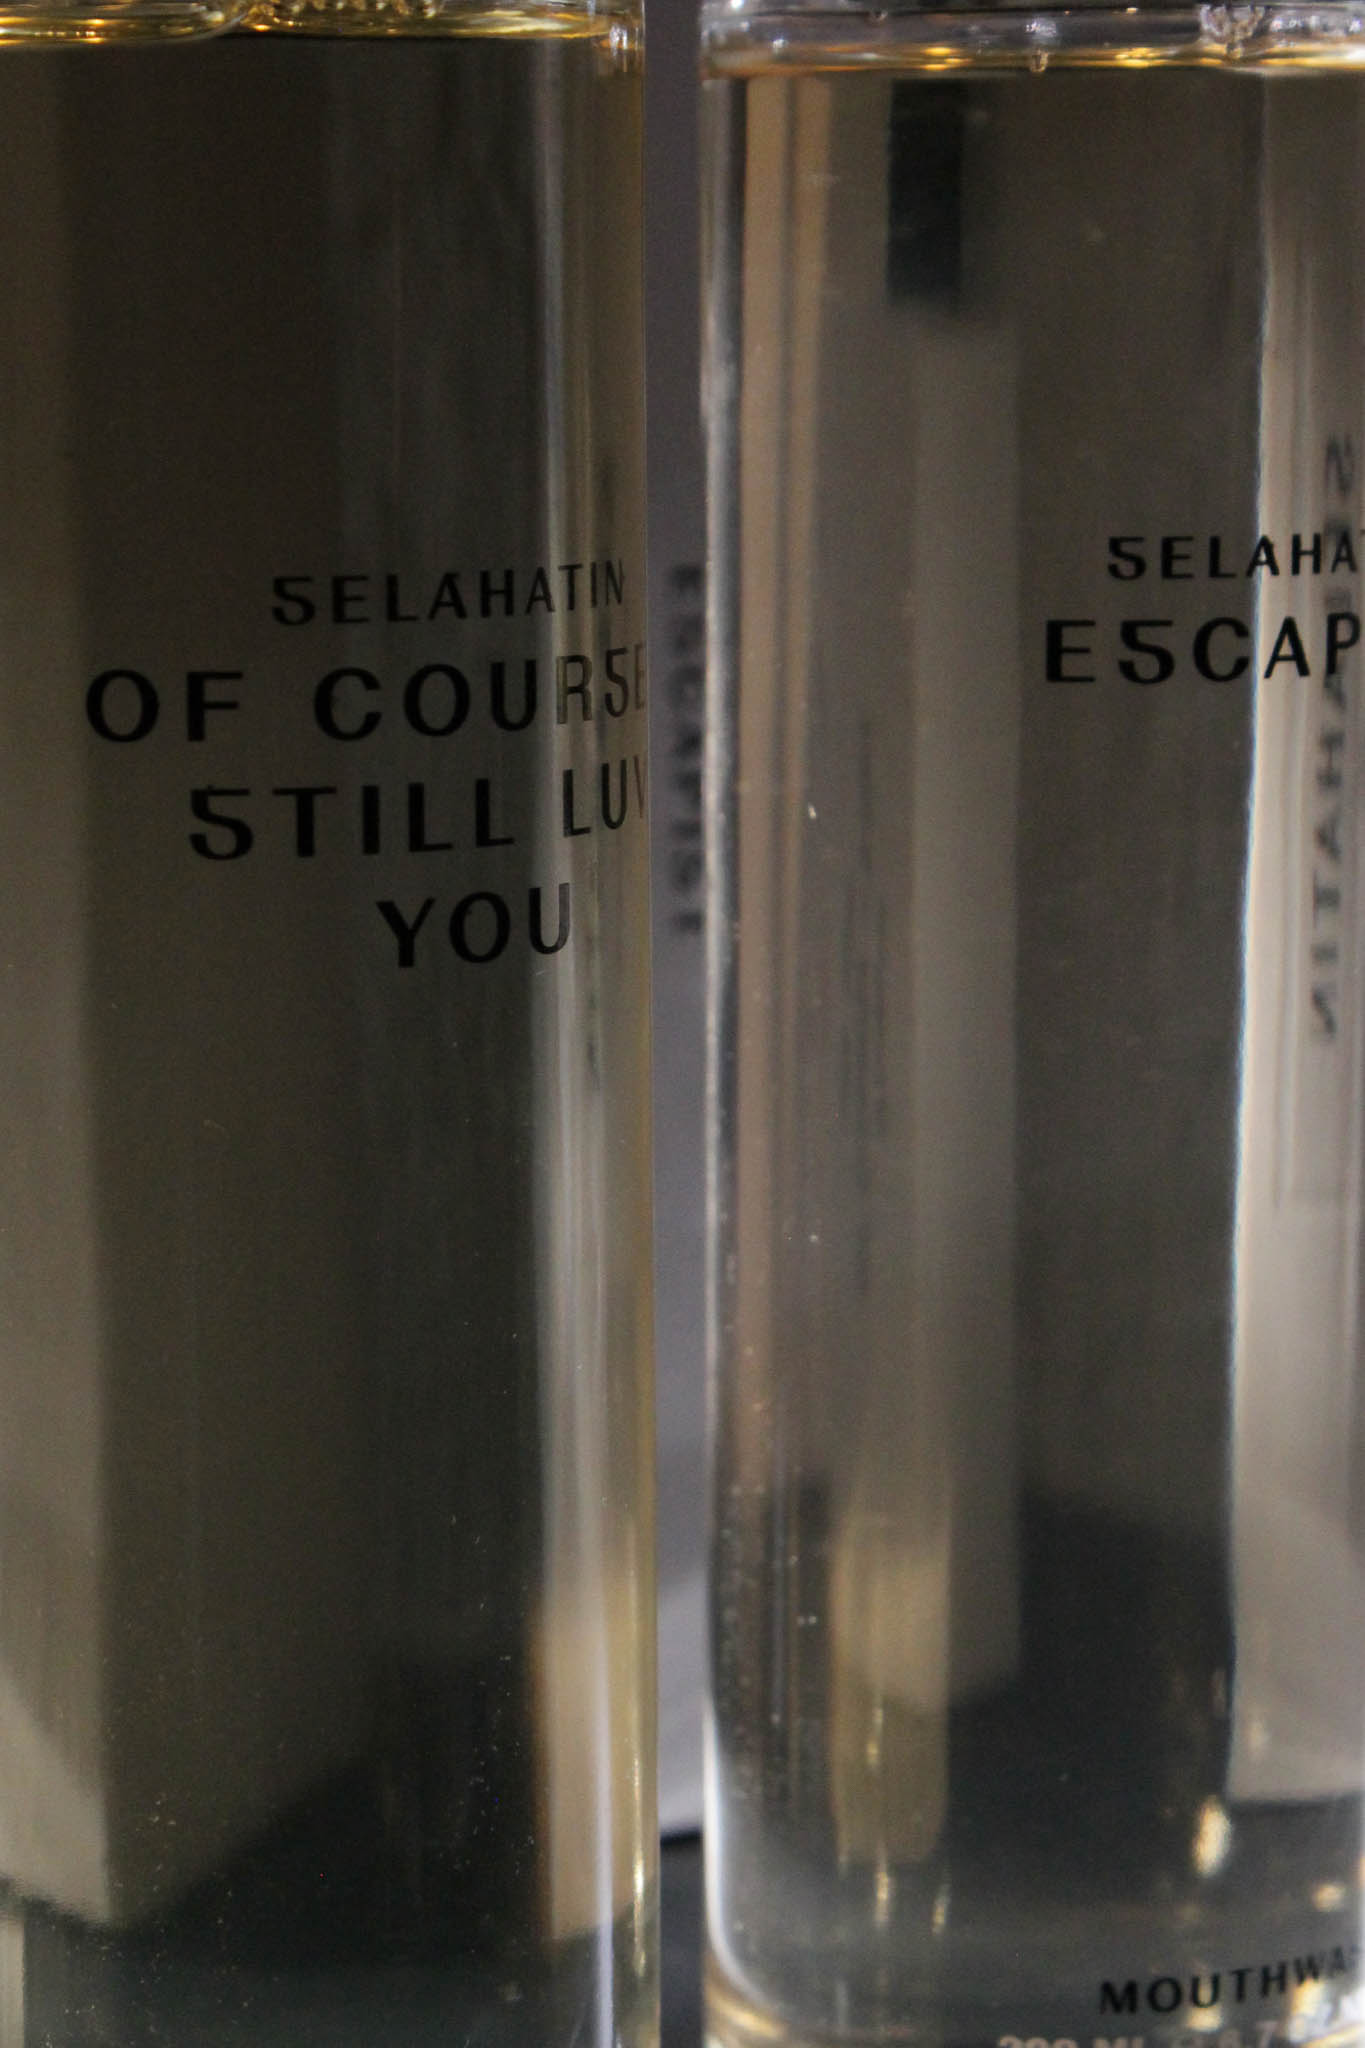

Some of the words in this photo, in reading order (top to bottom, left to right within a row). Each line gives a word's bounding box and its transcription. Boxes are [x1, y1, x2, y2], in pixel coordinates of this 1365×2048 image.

[271, 559, 625, 626] SELAHATIN
[1108, 532, 1365, 581] SELAHA
[85, 669, 245, 742] OF
[313, 642, 645, 741] COURSE
[189, 779, 515, 860] STILL
[376, 883, 571, 968] YOU
